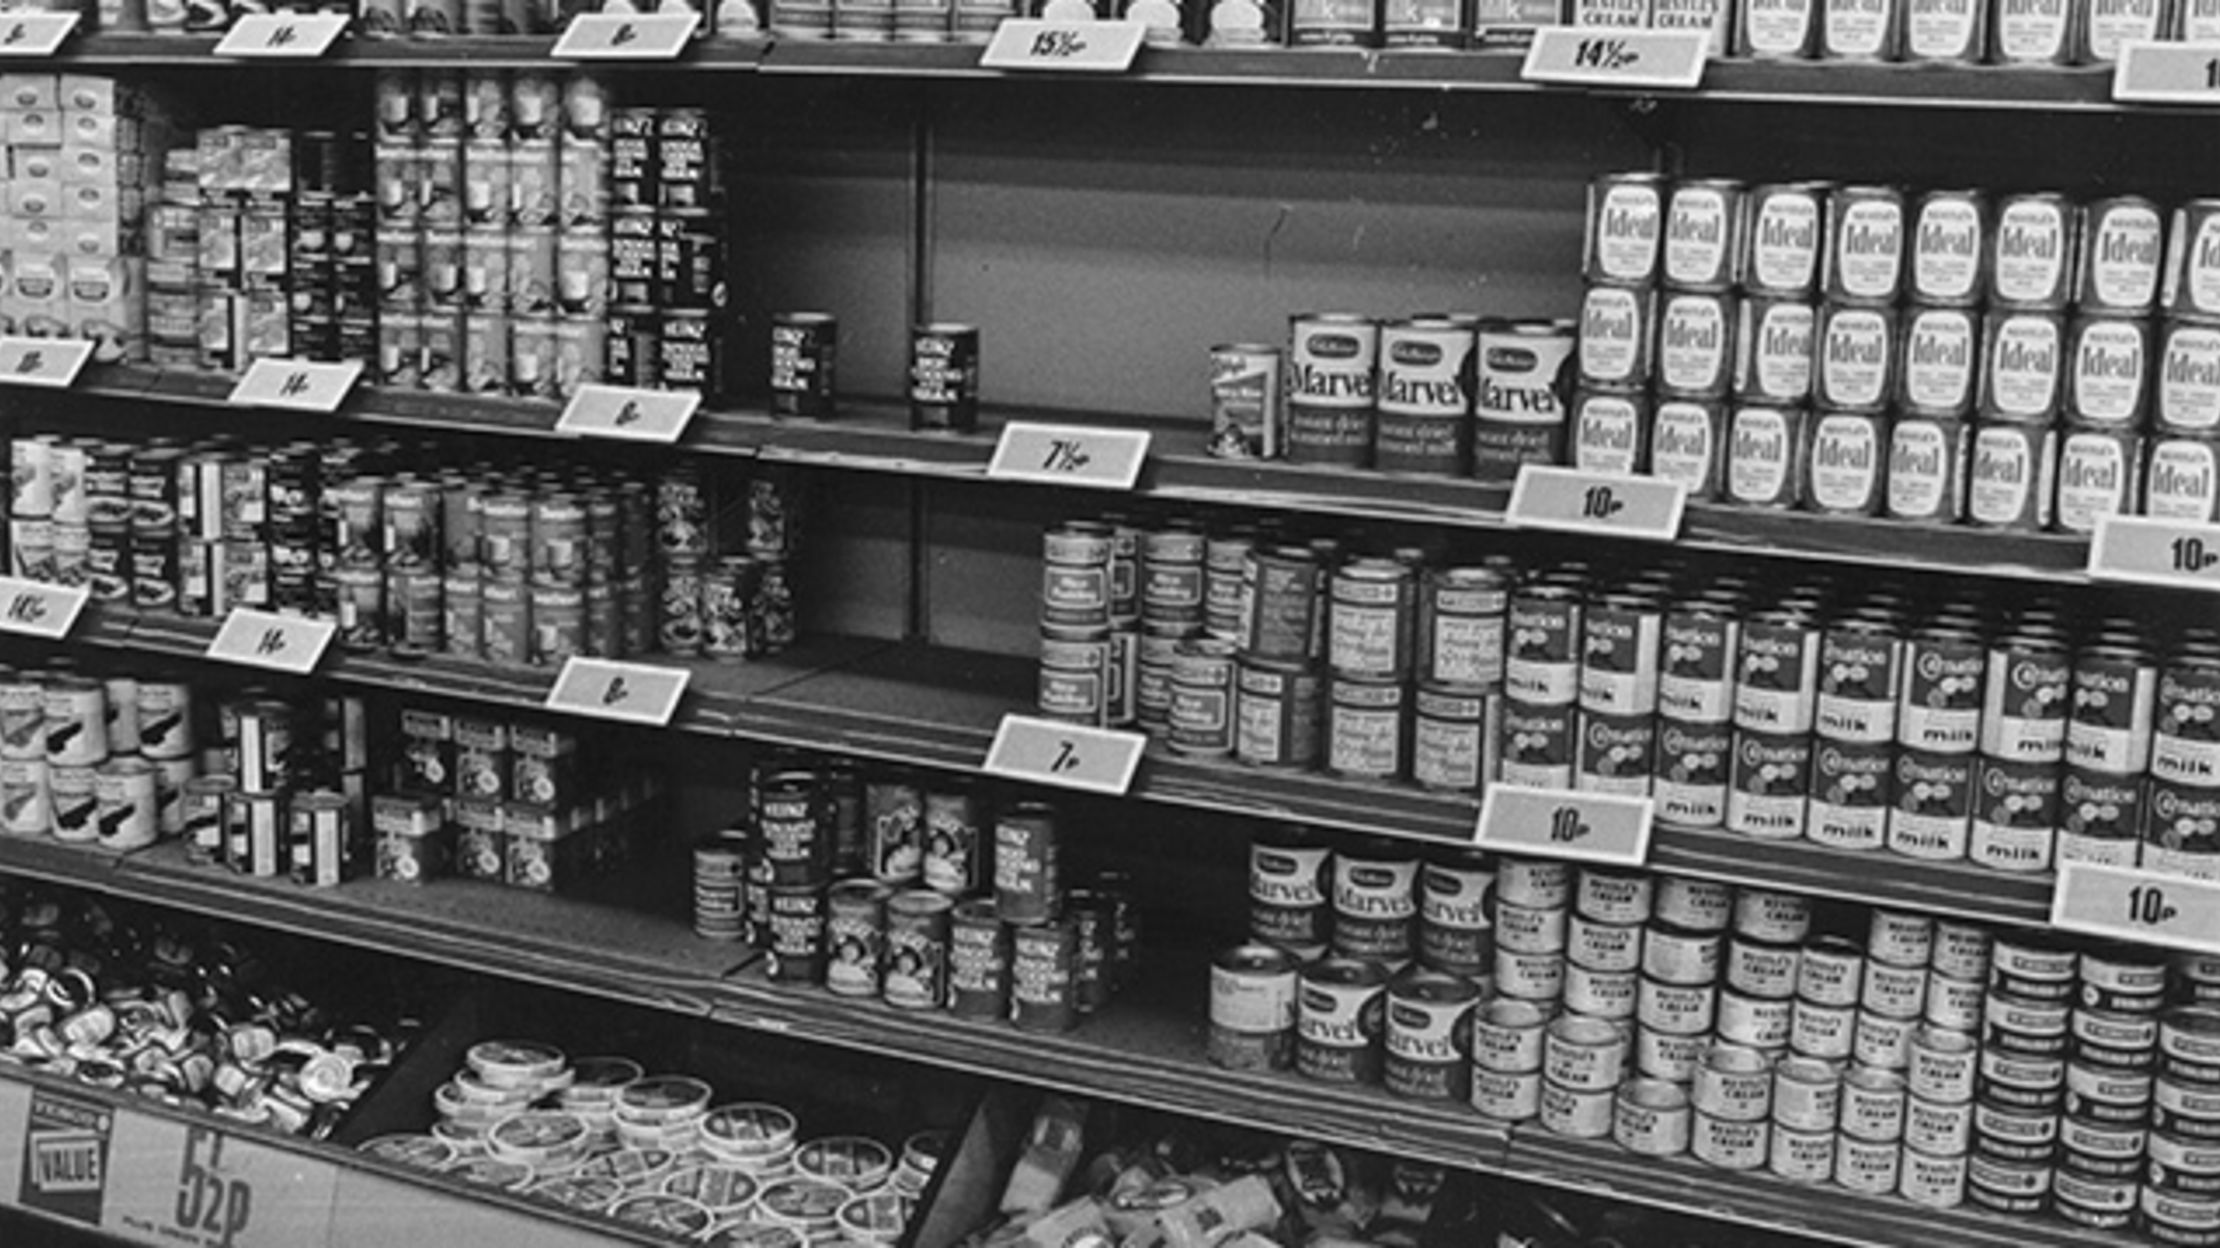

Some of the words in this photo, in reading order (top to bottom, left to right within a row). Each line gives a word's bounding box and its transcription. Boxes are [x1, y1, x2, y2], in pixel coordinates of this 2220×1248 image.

[1583, 13, 1639, 26] CREAM
[1659, 15, 1712, 27] CREAM
[2206, 58, 2220, 88] 1
[1583, 485, 1623, 518] 10p
[2170, 537, 2219, 572] 10p
[1551, 806, 1591, 842] 10p
[2128, 885, 2178, 926] 10p
[40, 1147, 97, 1182] VALUE
